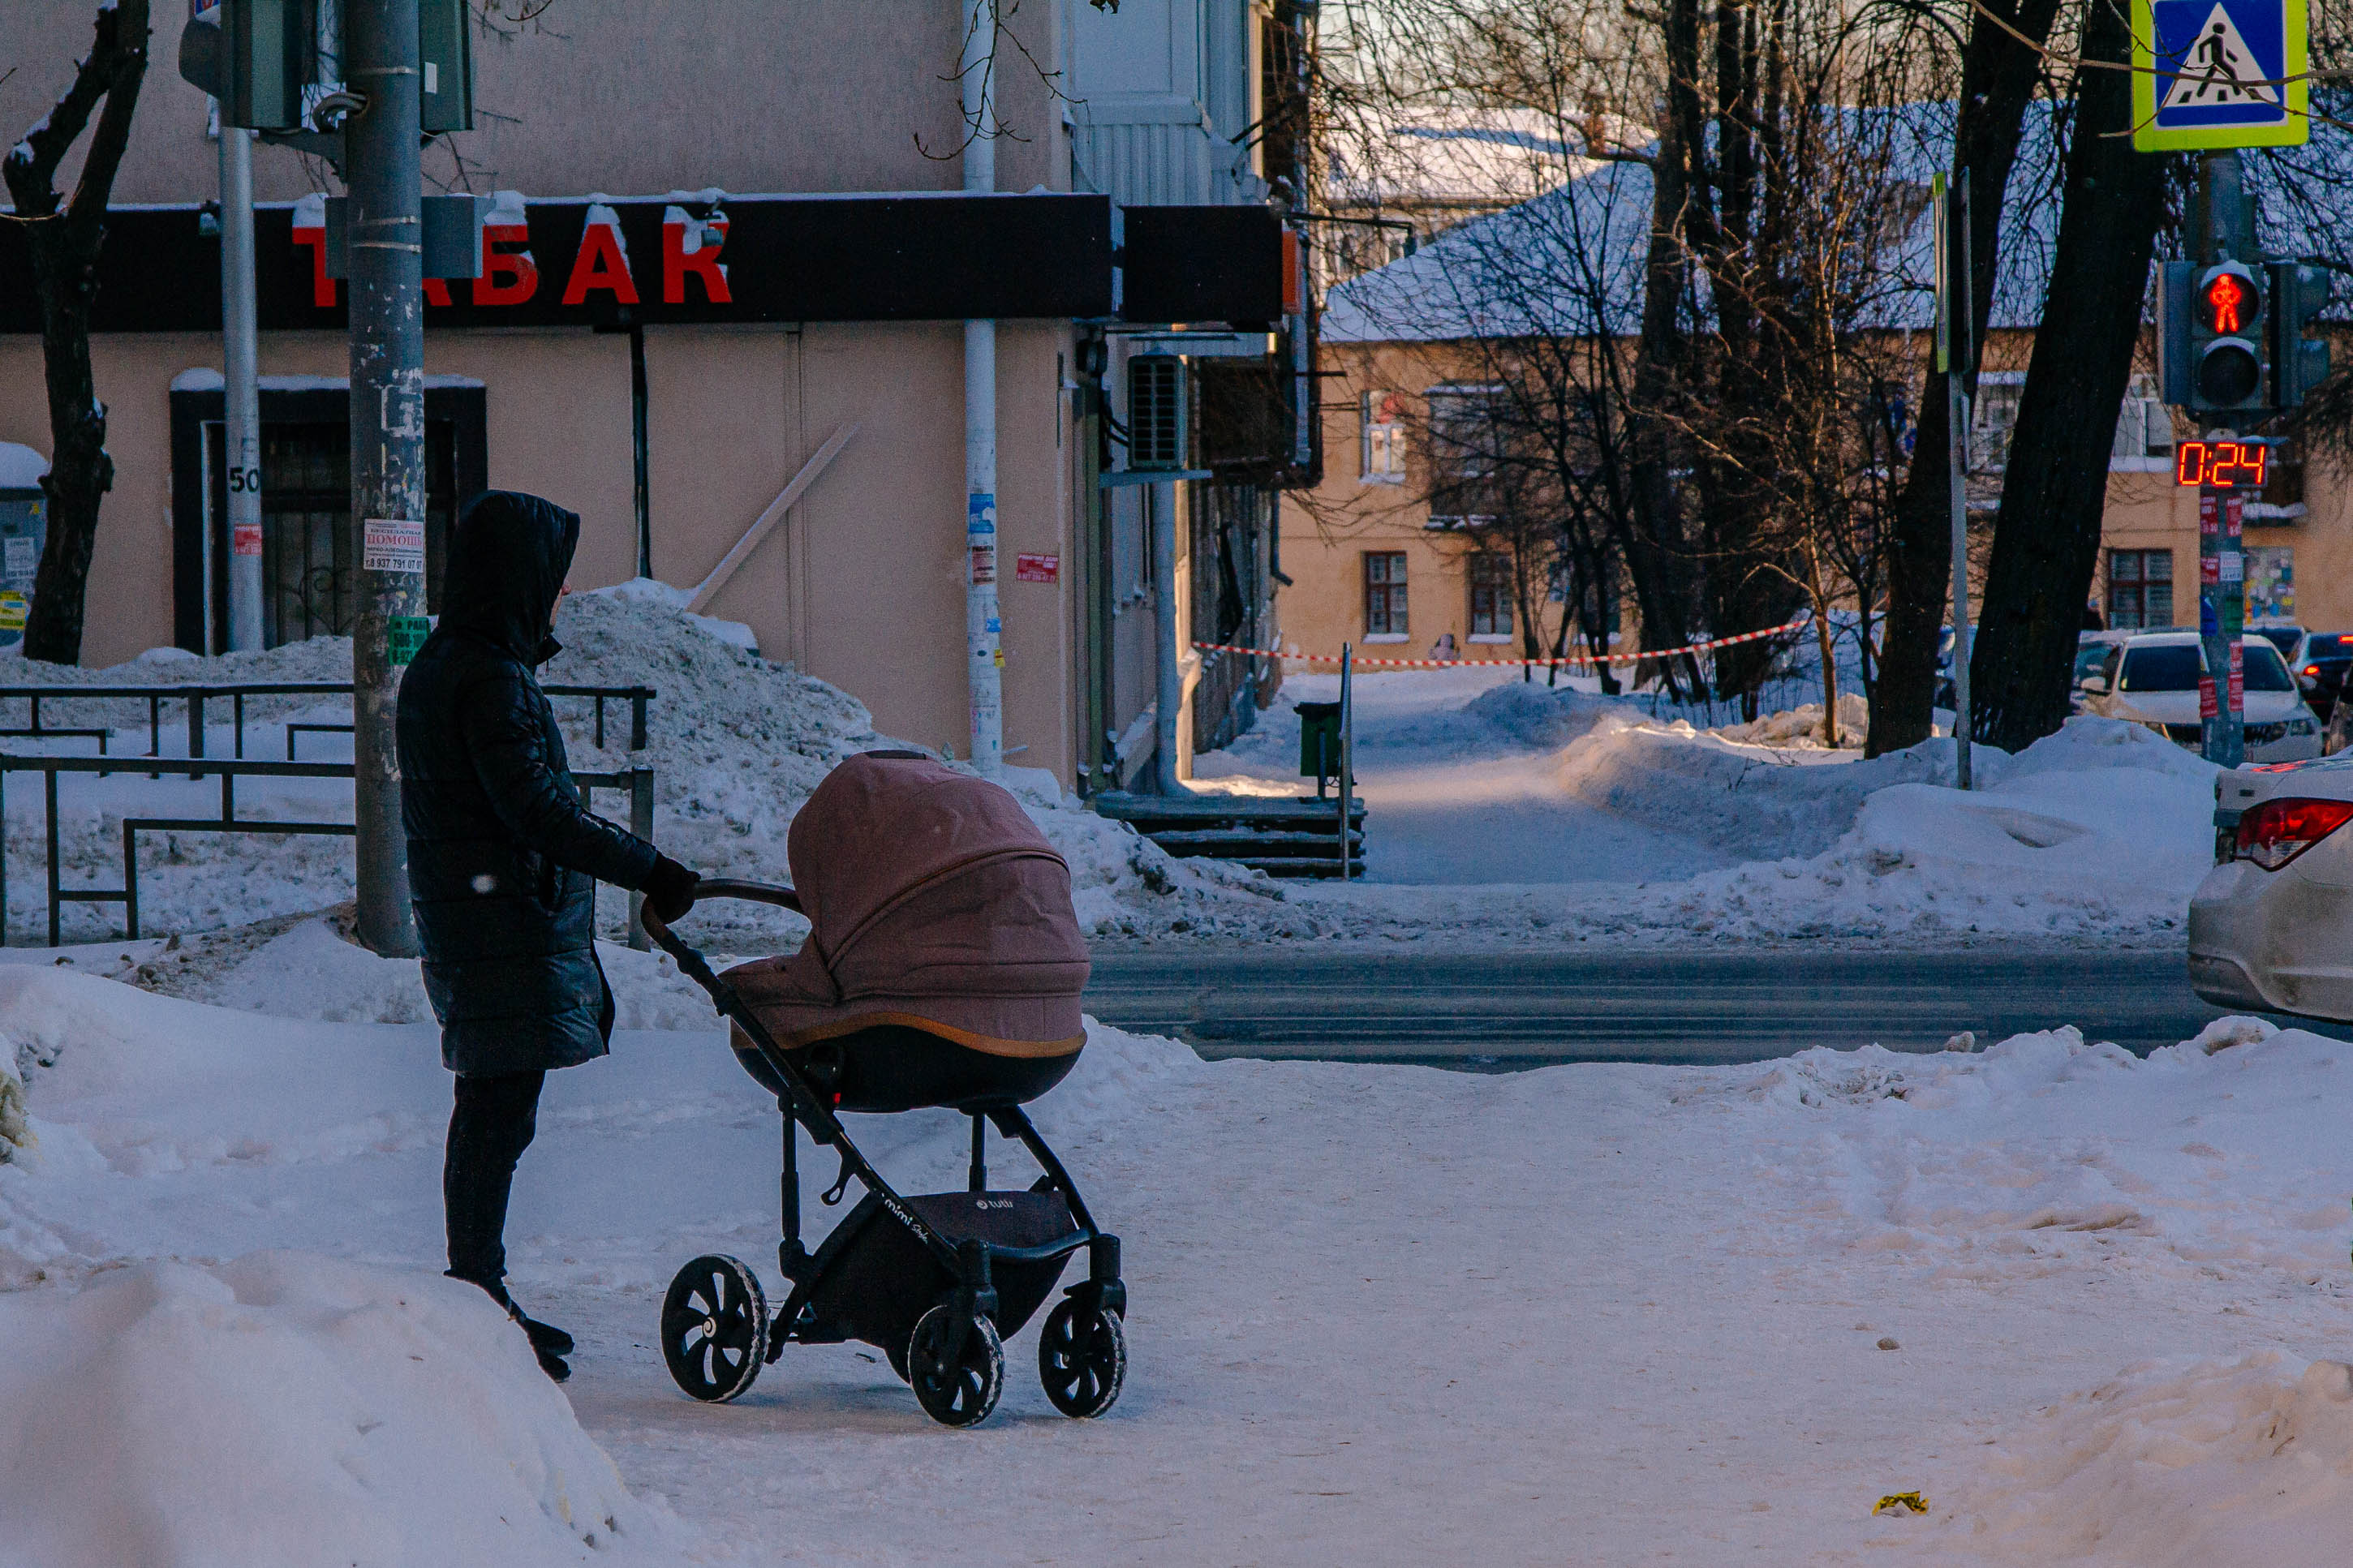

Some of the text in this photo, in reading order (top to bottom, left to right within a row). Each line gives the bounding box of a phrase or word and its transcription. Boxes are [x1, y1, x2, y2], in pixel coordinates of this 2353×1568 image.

[292, 222, 732, 307] ТБАК
[2179, 443, 2265, 485] 0:24
[230, 467, 260, 492] 50
[376, 558, 390, 568] 937
[393, 559, 406, 569] 791
[884, 1199, 914, 1226] mimi
